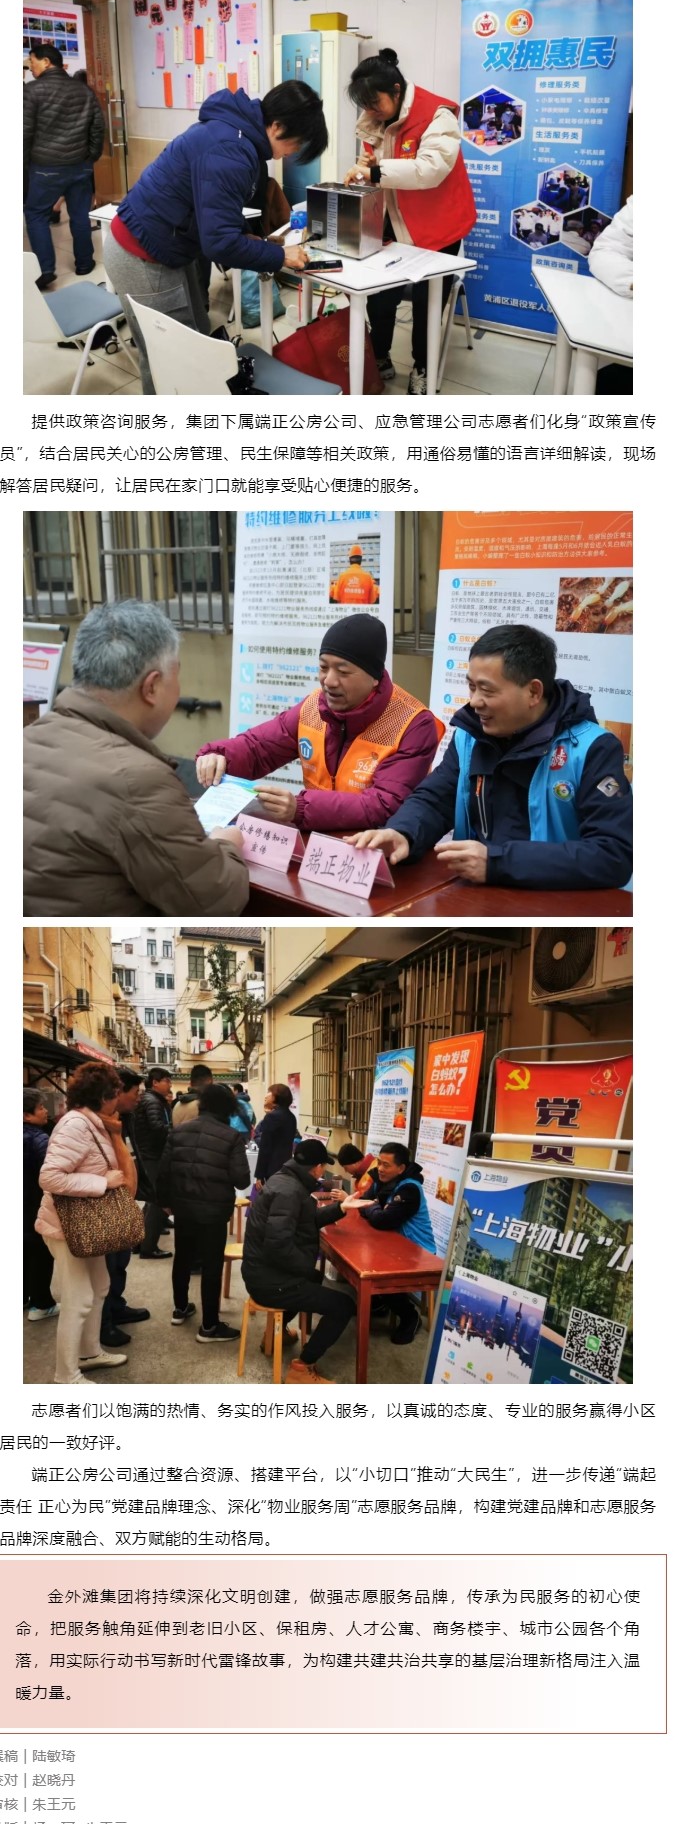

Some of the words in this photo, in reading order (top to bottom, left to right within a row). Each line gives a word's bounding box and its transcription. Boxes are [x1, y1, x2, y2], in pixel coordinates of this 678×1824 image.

[482, 35, 617, 71] 双拥惠民
[540, 80, 580, 89] 修理服务类
[536, 131, 580, 140] 生活服务类
[239, 822, 289, 846] 公房修缮知识
[306, 848, 371, 888] 端正物业
[433, 1049, 470, 1067] 家中发现
[429, 1083, 456, 1096] 怎么办
